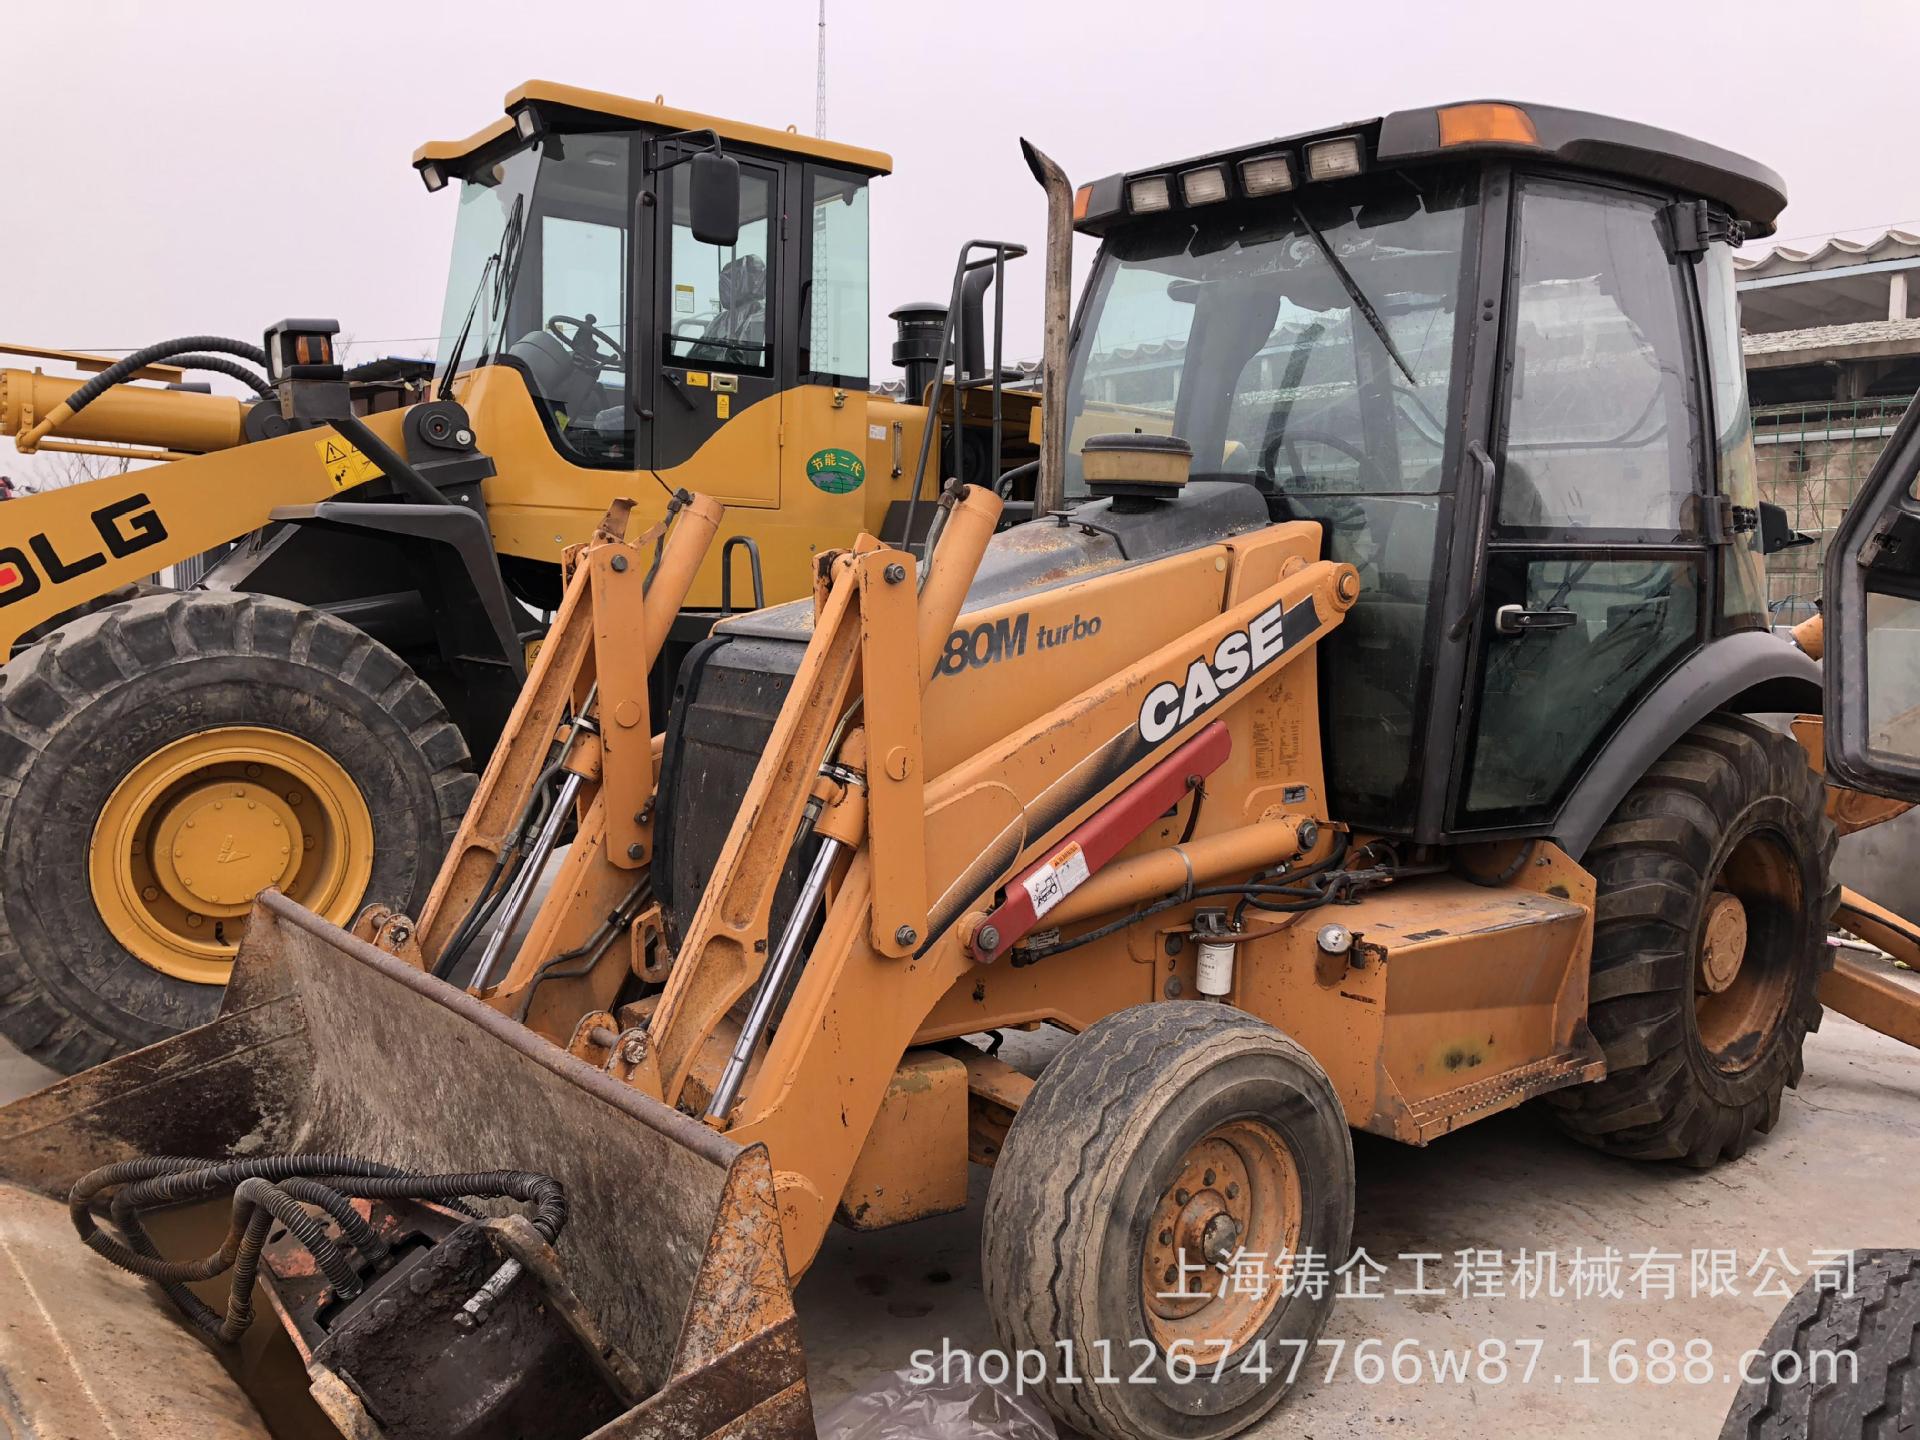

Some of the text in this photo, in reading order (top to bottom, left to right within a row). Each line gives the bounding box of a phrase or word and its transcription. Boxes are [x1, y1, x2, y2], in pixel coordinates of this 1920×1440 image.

[811, 453, 861, 476] 节能二代
[931, 613, 1102, 680] 80M turbo
[1139, 599, 1284, 743] CASE
